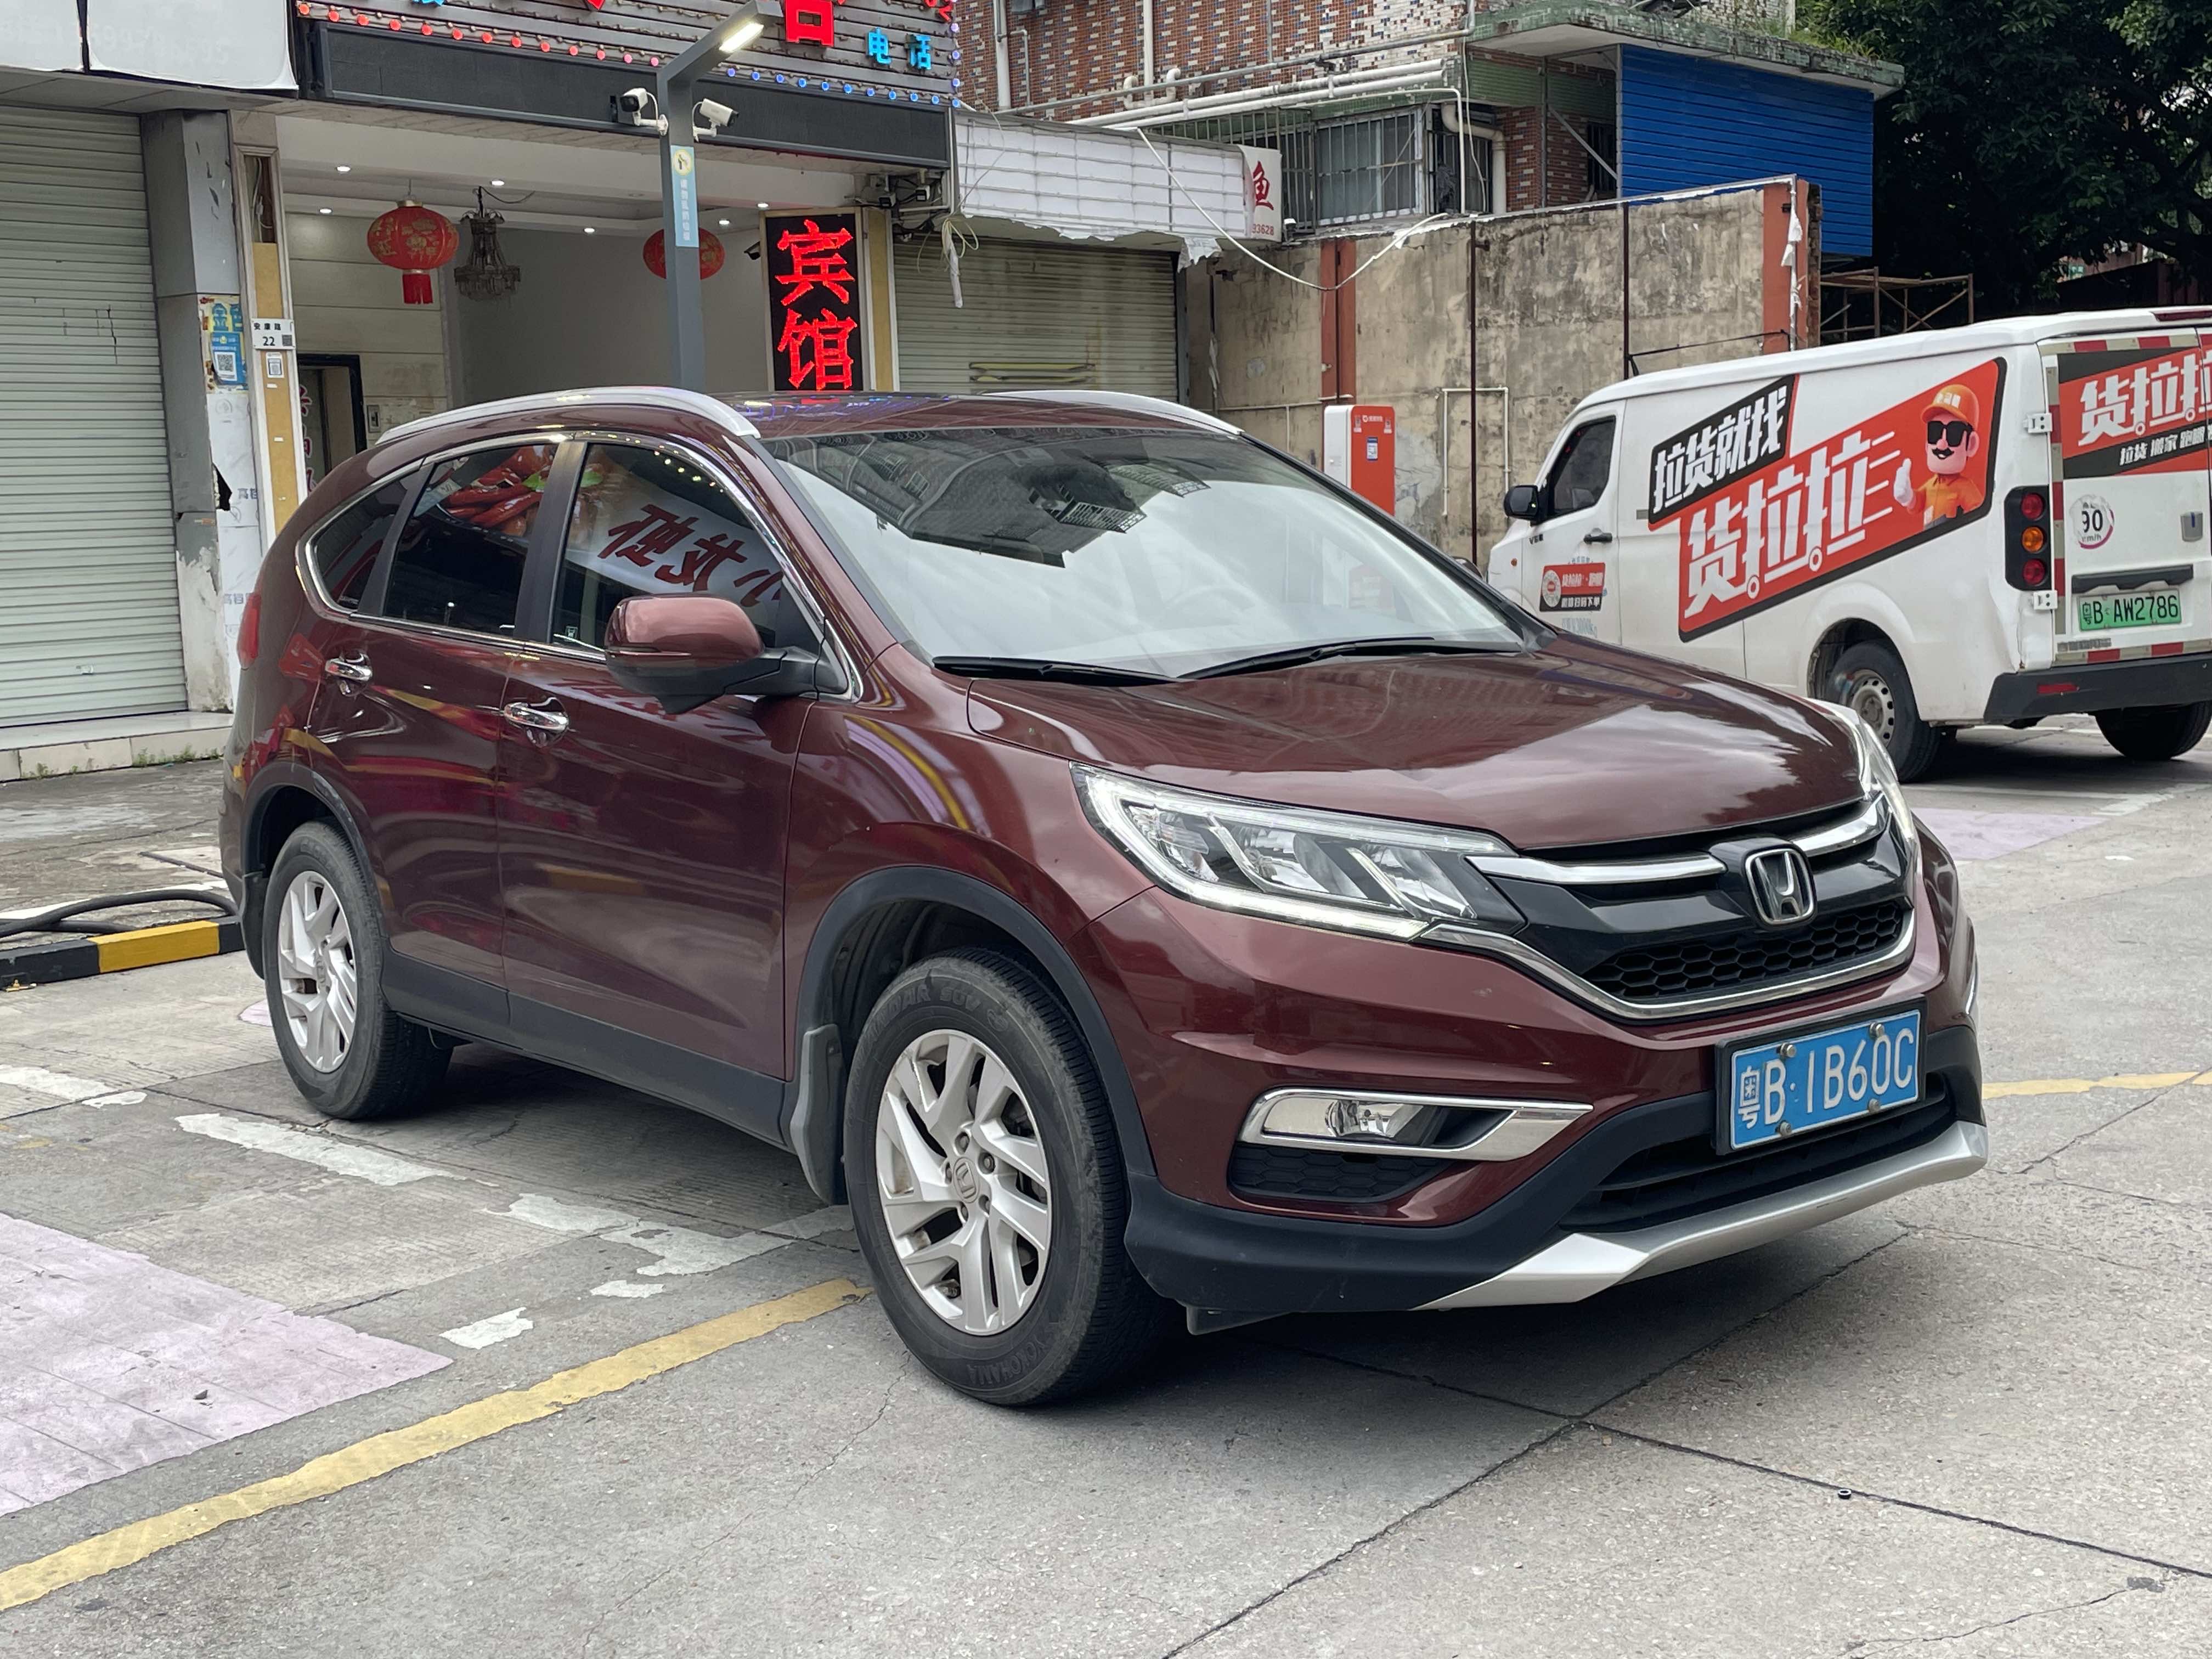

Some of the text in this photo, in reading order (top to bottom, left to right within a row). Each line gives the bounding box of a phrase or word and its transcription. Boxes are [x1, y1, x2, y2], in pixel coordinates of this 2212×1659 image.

[868, 27, 931, 70] 电话
[1253, 161, 1274, 211] 鱼
[775, 219, 857, 391] 宾馆
[263, 336, 275, 346] 22
[1653, 386, 1787, 514] 拉货就找
[1684, 431, 1870, 618] 货拉拉
[967, 1334, 1046, 1385] YOKOHAMA
